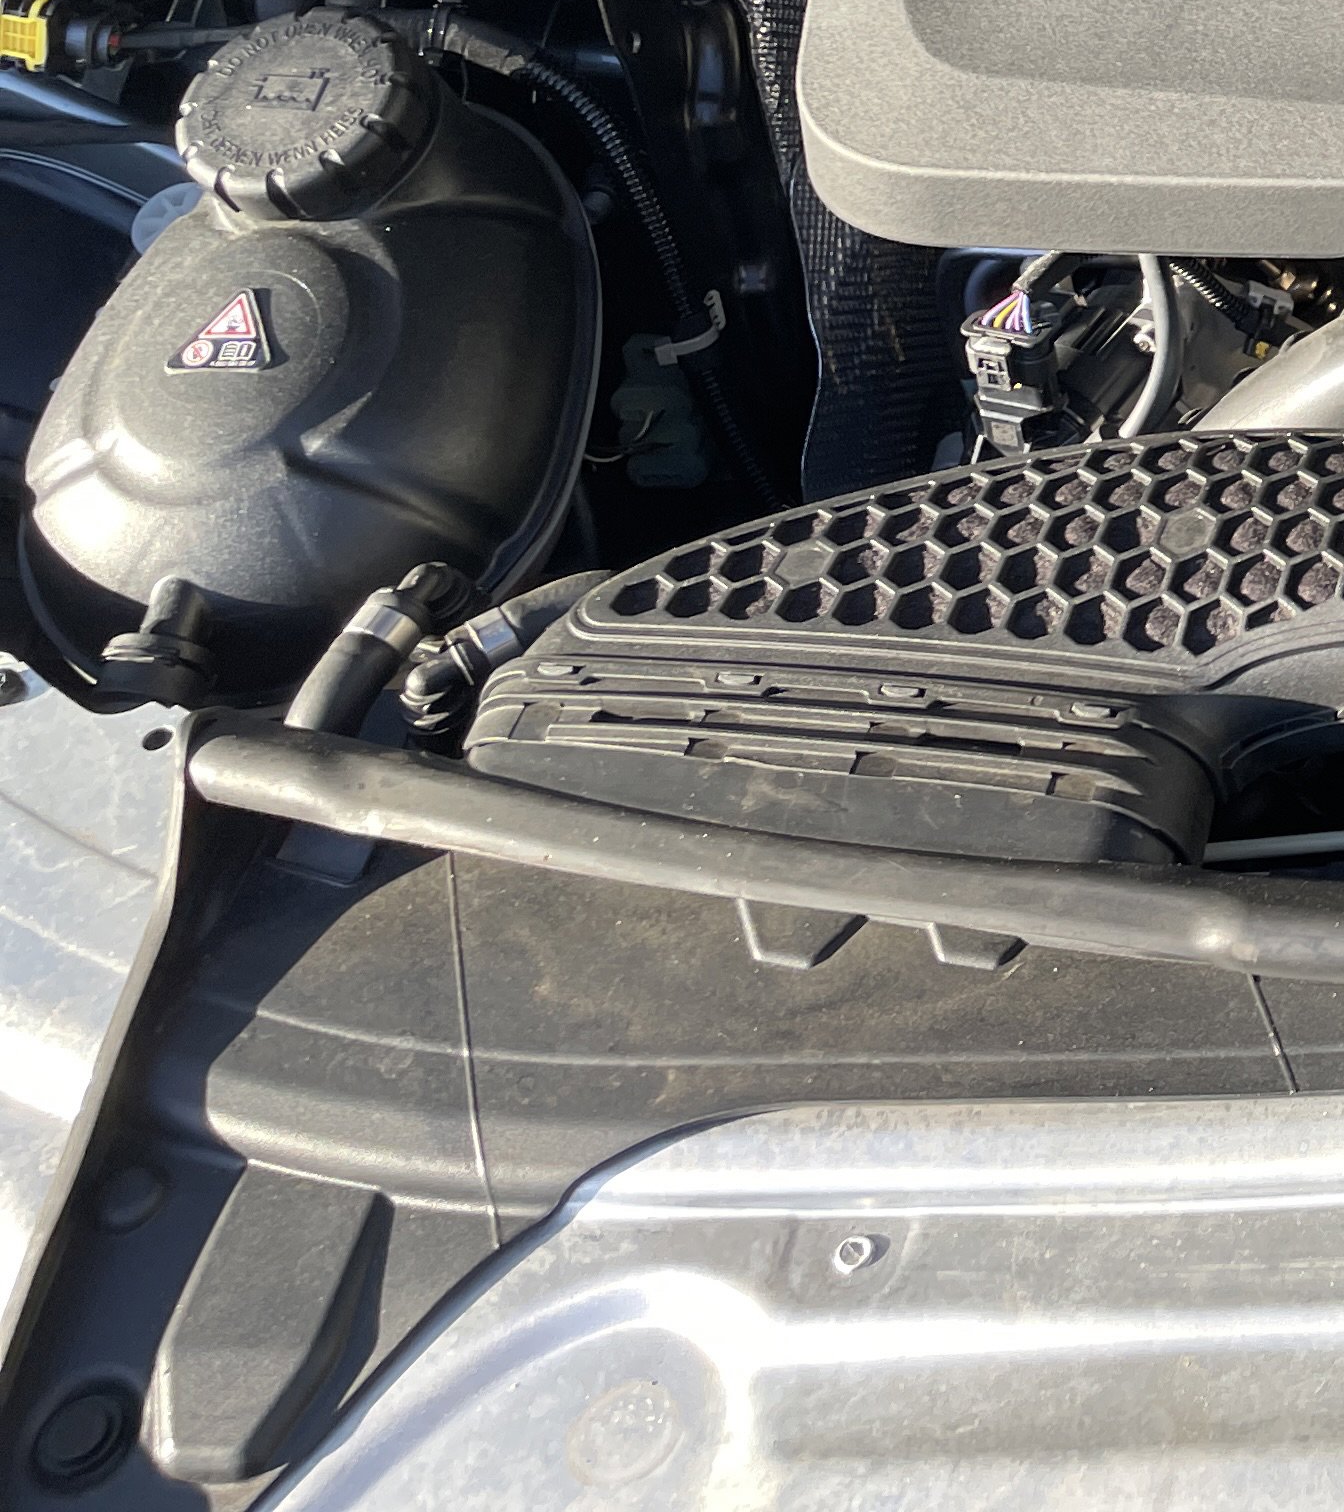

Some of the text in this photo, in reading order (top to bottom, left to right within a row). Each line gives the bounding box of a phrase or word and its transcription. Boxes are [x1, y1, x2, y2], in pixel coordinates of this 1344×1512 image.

[243, 31, 279, 57] NOT
[268, 140, 319, 166] WENN
[319, 107, 364, 146] HEISS
